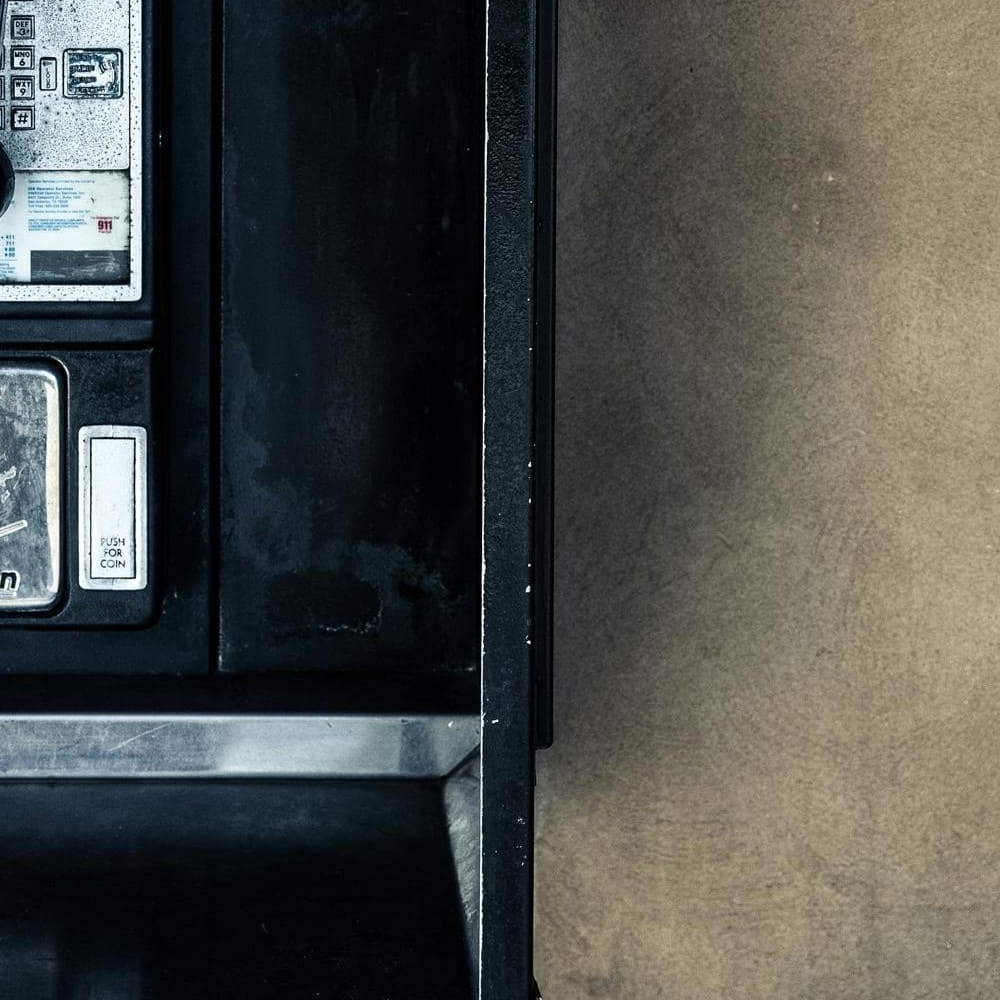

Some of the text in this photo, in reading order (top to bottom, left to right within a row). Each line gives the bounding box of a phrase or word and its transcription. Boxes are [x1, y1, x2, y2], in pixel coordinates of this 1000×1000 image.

[19, 28, 26, 36] 3
[19, 88, 26, 96] 9
[97, 220, 113, 230] 911
[100, 537, 126, 547] PUSH
[99, 559, 126, 569] COIN
